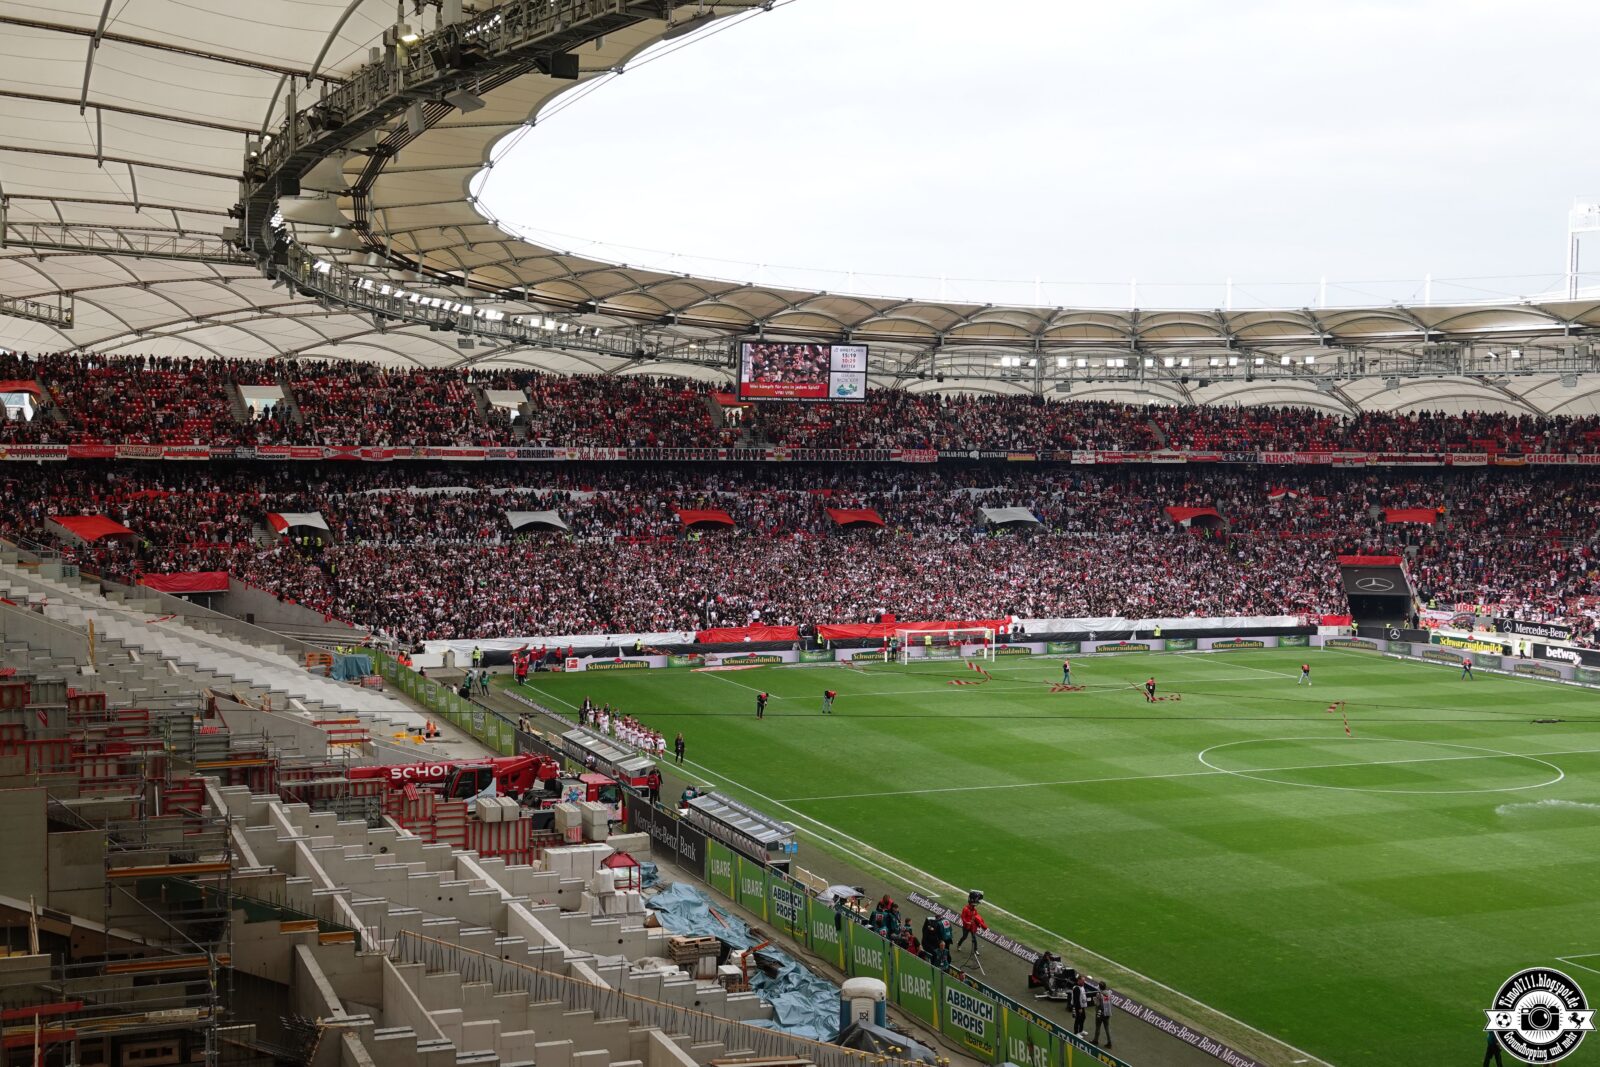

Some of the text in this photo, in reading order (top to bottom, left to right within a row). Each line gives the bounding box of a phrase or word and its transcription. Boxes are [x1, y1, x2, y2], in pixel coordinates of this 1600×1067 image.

[517, 449, 554, 458] BERKHEIM
[626, 448, 891, 460] CANNSTATTER KURVE NECKARSTADION
[1455, 604, 1491, 613] URBCH
[1515, 623, 1568, 640] Mercedes-Benz
[587, 661, 648, 670] Schwarzwaldmilch
[680, 836, 697, 862] Bank
[711, 859, 731, 878] LIBARE
[741, 877, 763, 898] LIBARE
[813, 920, 839, 944] LIBARE
[996, 936, 1014, 953] Bank
[854, 945, 883, 970] LIBARE
[900, 973, 932, 1000] LIBARE
[947, 989, 993, 1022] ABBRUCH
[952, 1009, 984, 1036] PROFIS
[1121, 998, 1144, 1017] Bank
[1140, 1008, 1201, 1046] Mercedes-Benz
[1198, 1035, 1223, 1057] Bank
